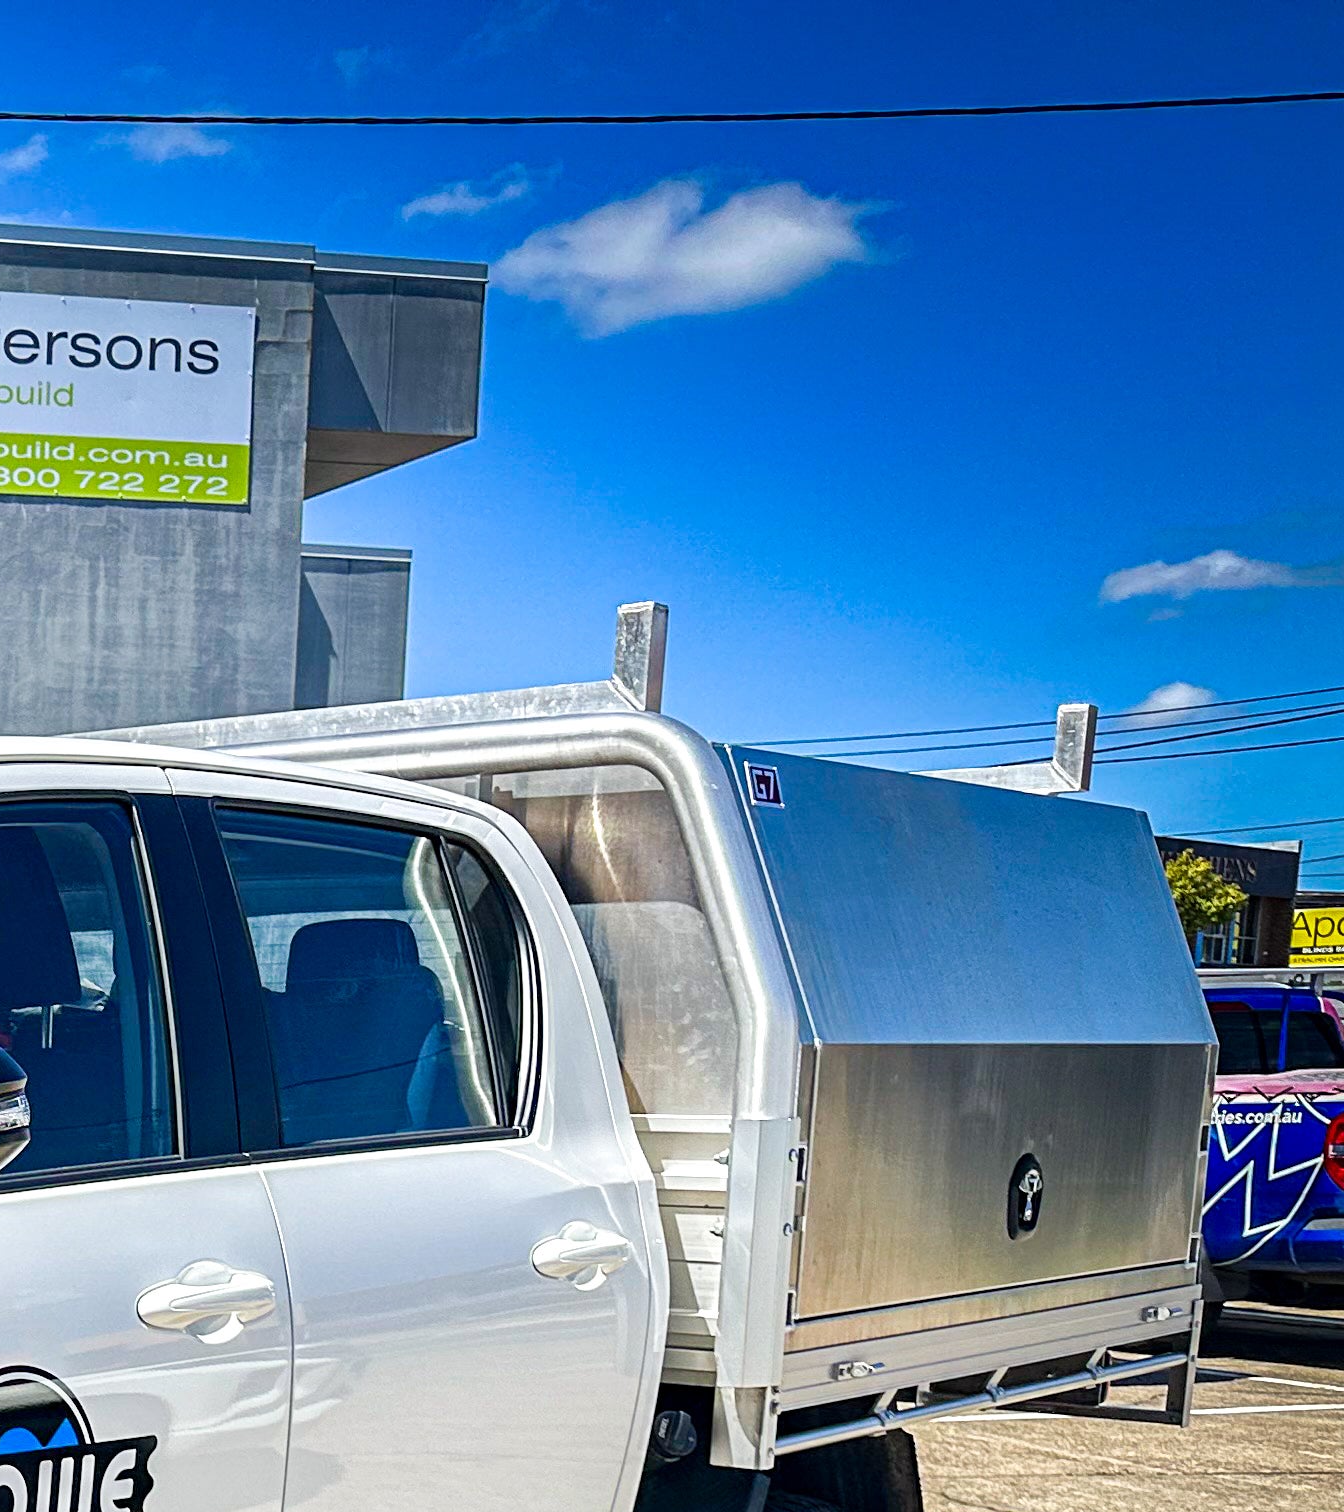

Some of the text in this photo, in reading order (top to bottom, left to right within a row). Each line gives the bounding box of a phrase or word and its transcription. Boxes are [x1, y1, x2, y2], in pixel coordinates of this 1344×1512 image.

[74, 470, 145, 492] 722
[158, 475, 229, 496] 272
[751, 768, 775, 800] G7
